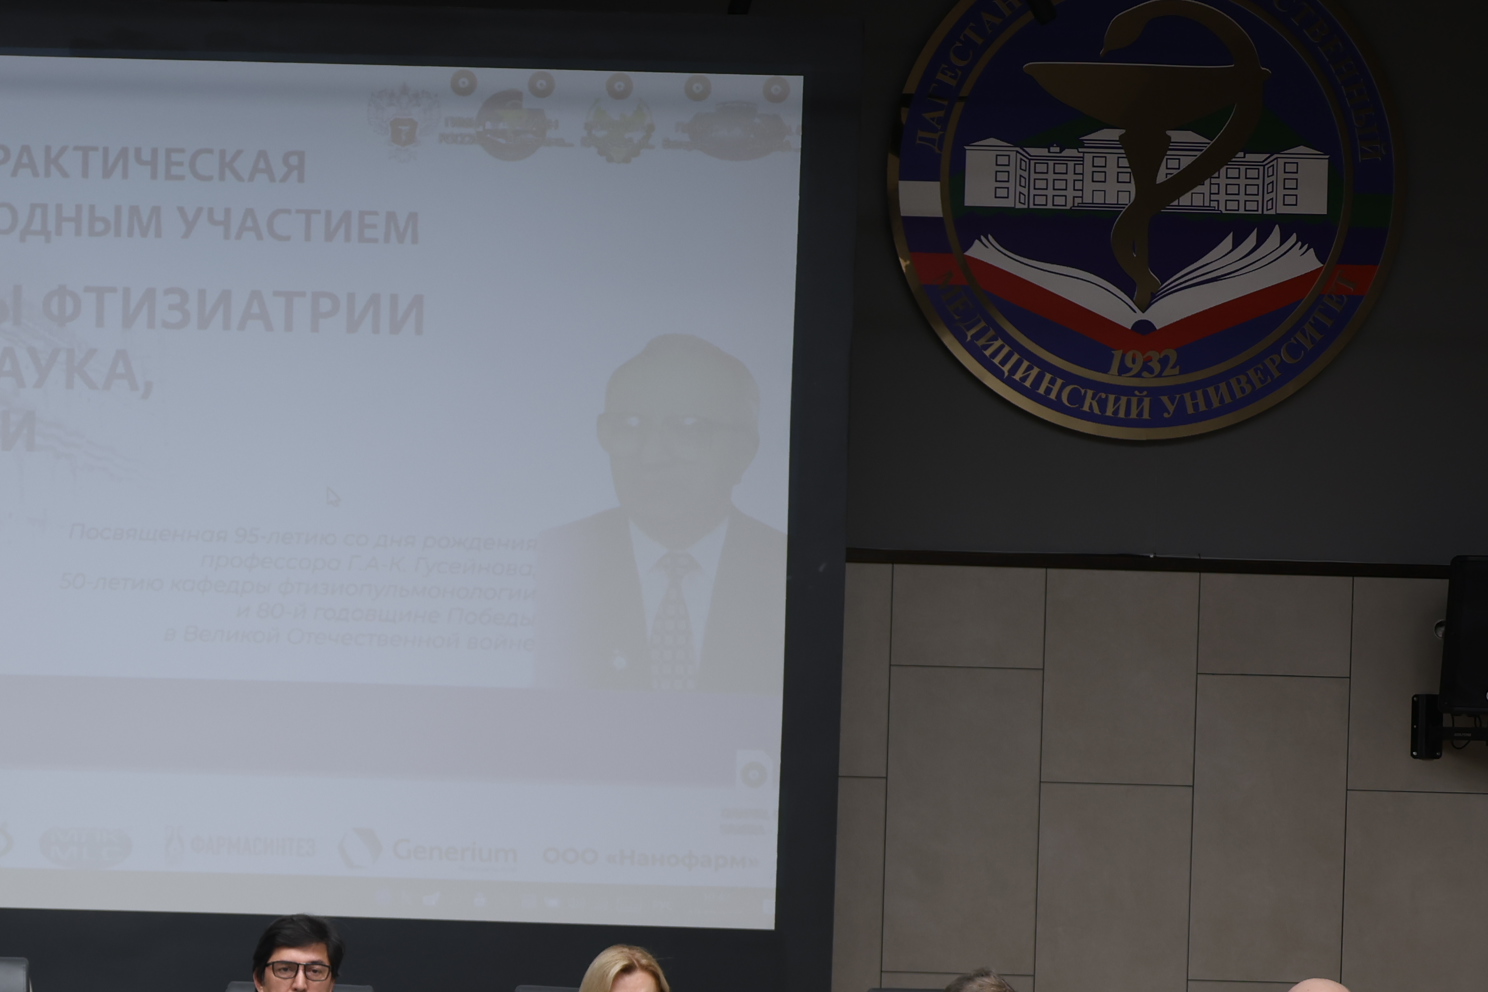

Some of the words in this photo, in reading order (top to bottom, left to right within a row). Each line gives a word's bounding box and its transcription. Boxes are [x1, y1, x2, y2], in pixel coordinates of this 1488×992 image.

[178, 206, 420, 245] УЧАСТИЕМ
[42, 283, 425, 336] ФТИЗИАТРИИ
[934, 272, 1152, 419] МЕДИЦИНСКИЙ
[1163, 270, 1358, 418] УНИВЕРСИТЕТ
[1106, 348, 1180, 379] 1932
[190, 834, 317, 858] ФАРМАСИНТЕЗ
[392, 837, 518, 864] Generium
[542, 846, 598, 866] ООО
